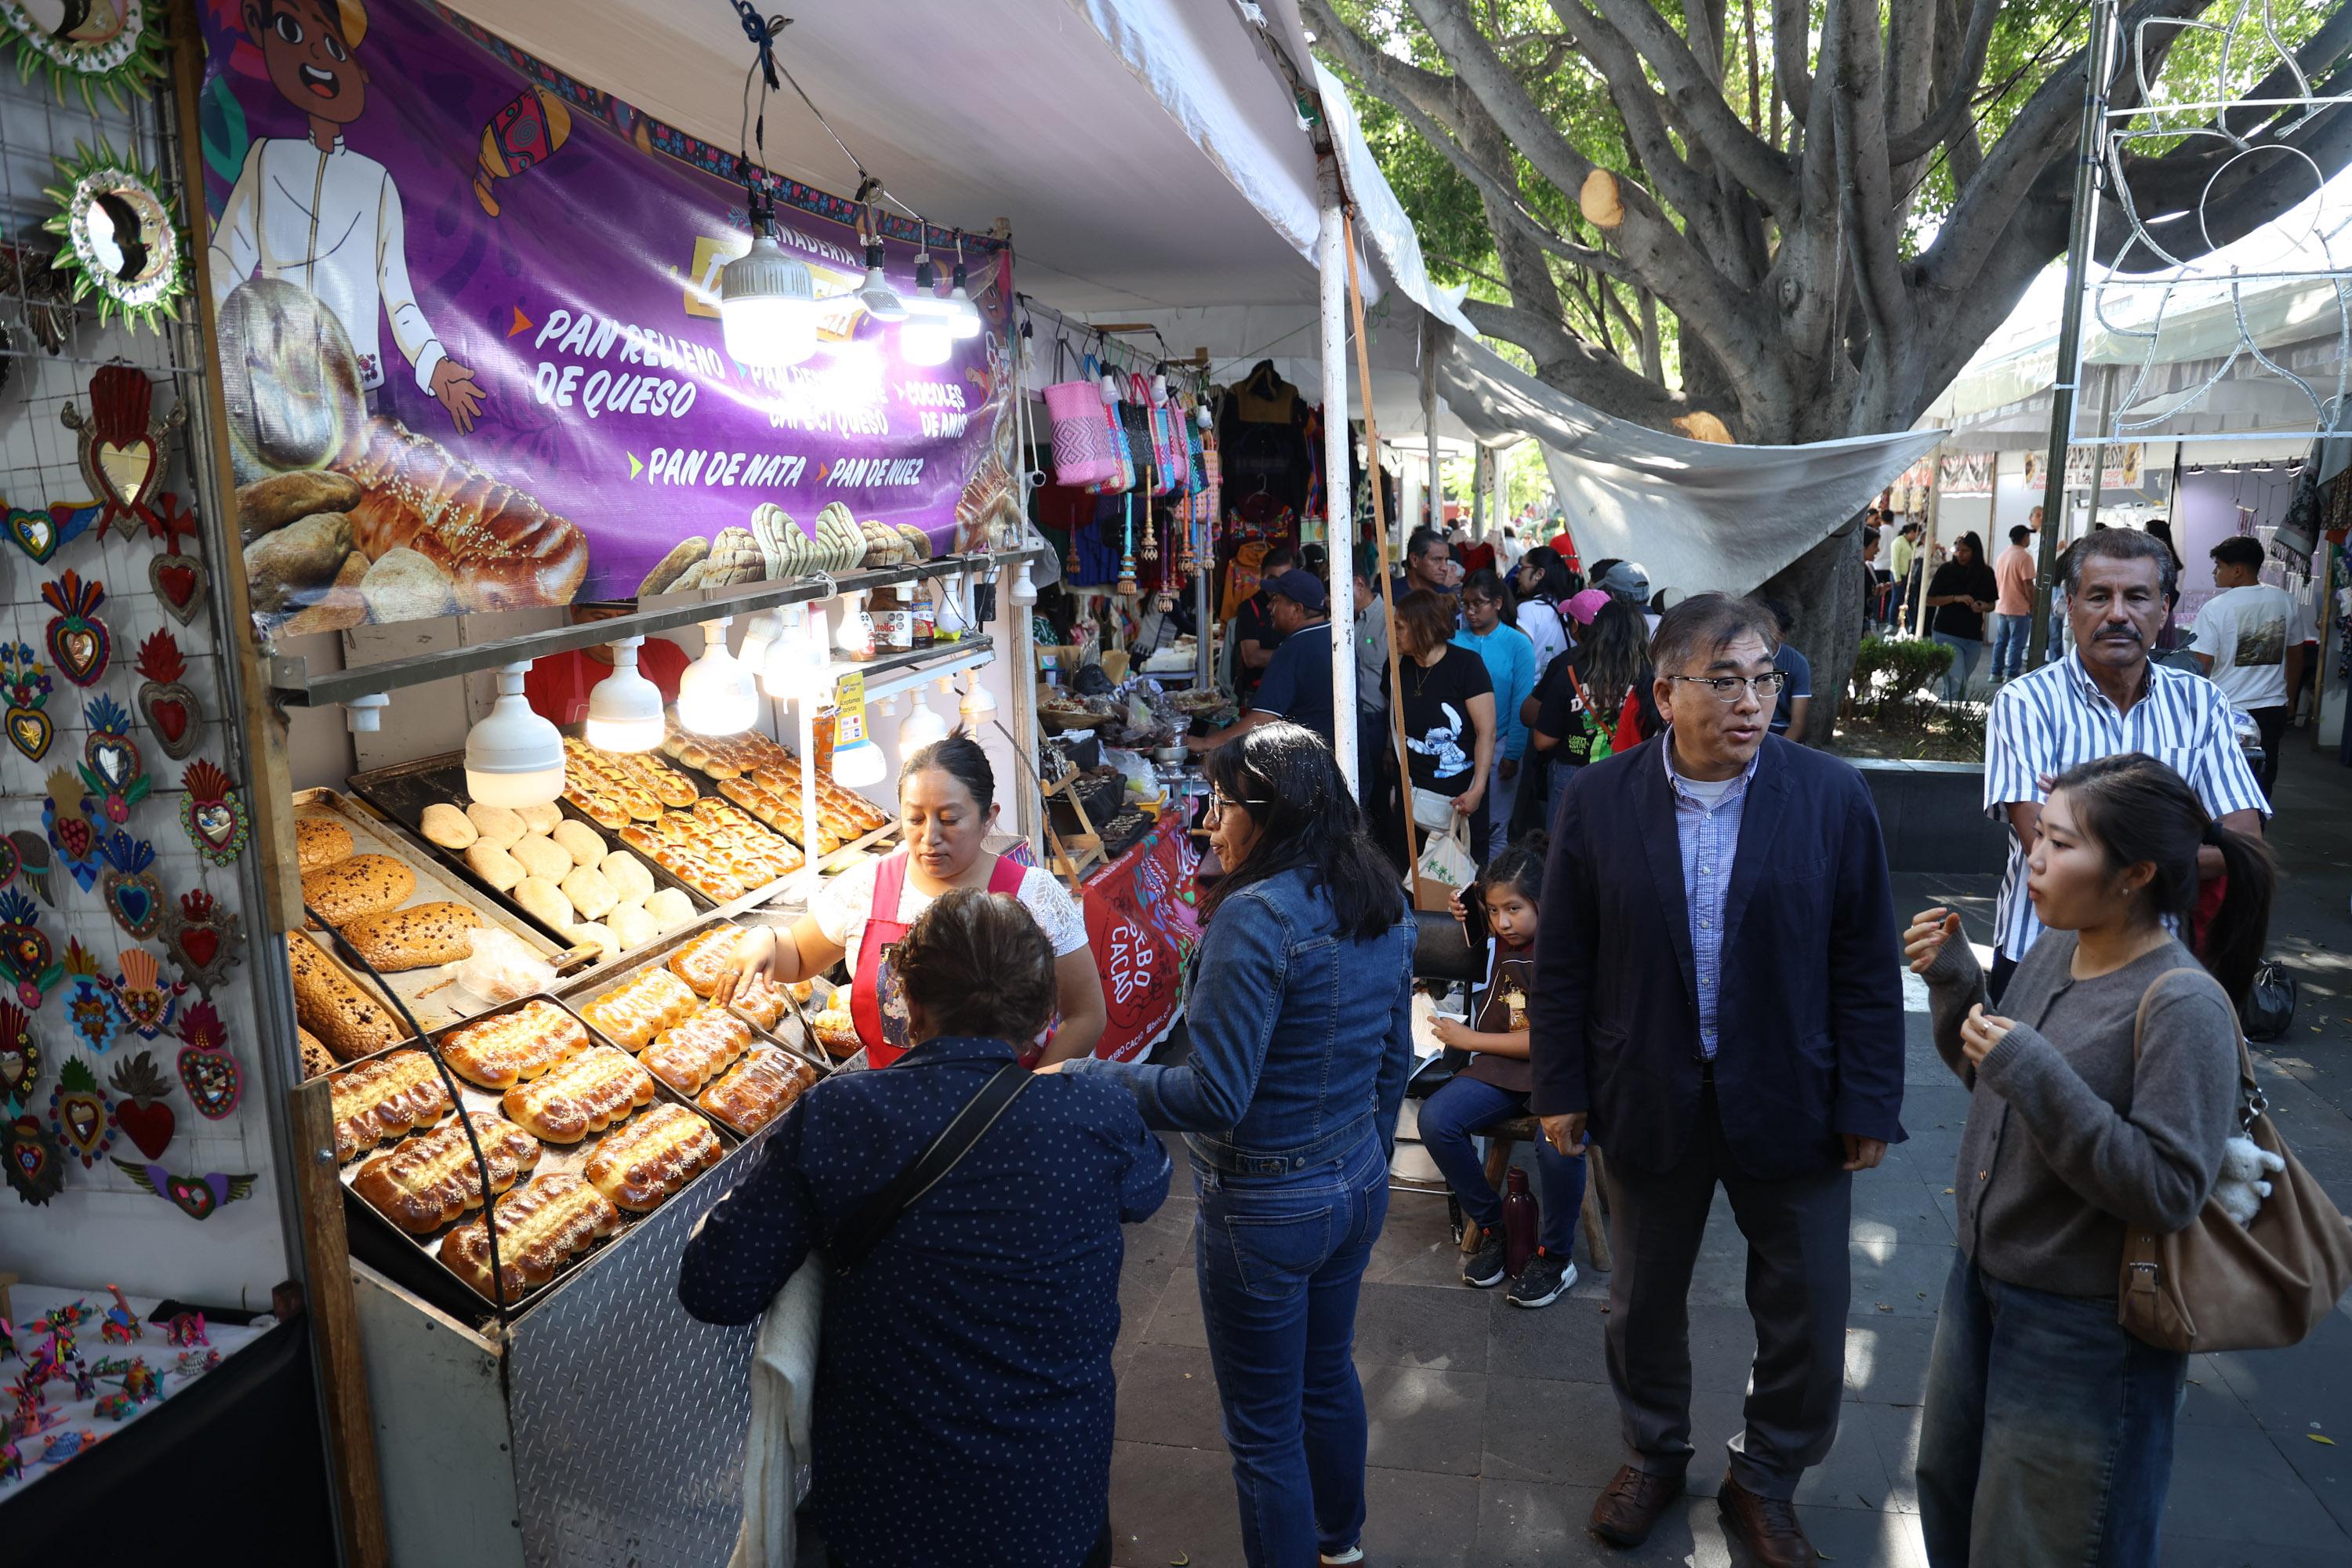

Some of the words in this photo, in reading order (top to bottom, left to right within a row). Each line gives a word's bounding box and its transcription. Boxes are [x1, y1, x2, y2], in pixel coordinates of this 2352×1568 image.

[535, 310, 619, 359] PAN
[619, 324, 726, 379] RELLENO
[535, 361, 584, 407] DE
[583, 369, 697, 419] QUESO
[905, 379, 966, 409] COCOLES
[919, 410, 940, 439] DE
[648, 447, 708, 486] PAN
[704, 451, 746, 487] DE
[739, 453, 807, 488] NATA
[826, 458, 870, 488] PAN
[866, 458, 889, 488] DE
[884, 457, 924, 487] NUEZ
[1110, 926, 1134, 1004] CACAO
